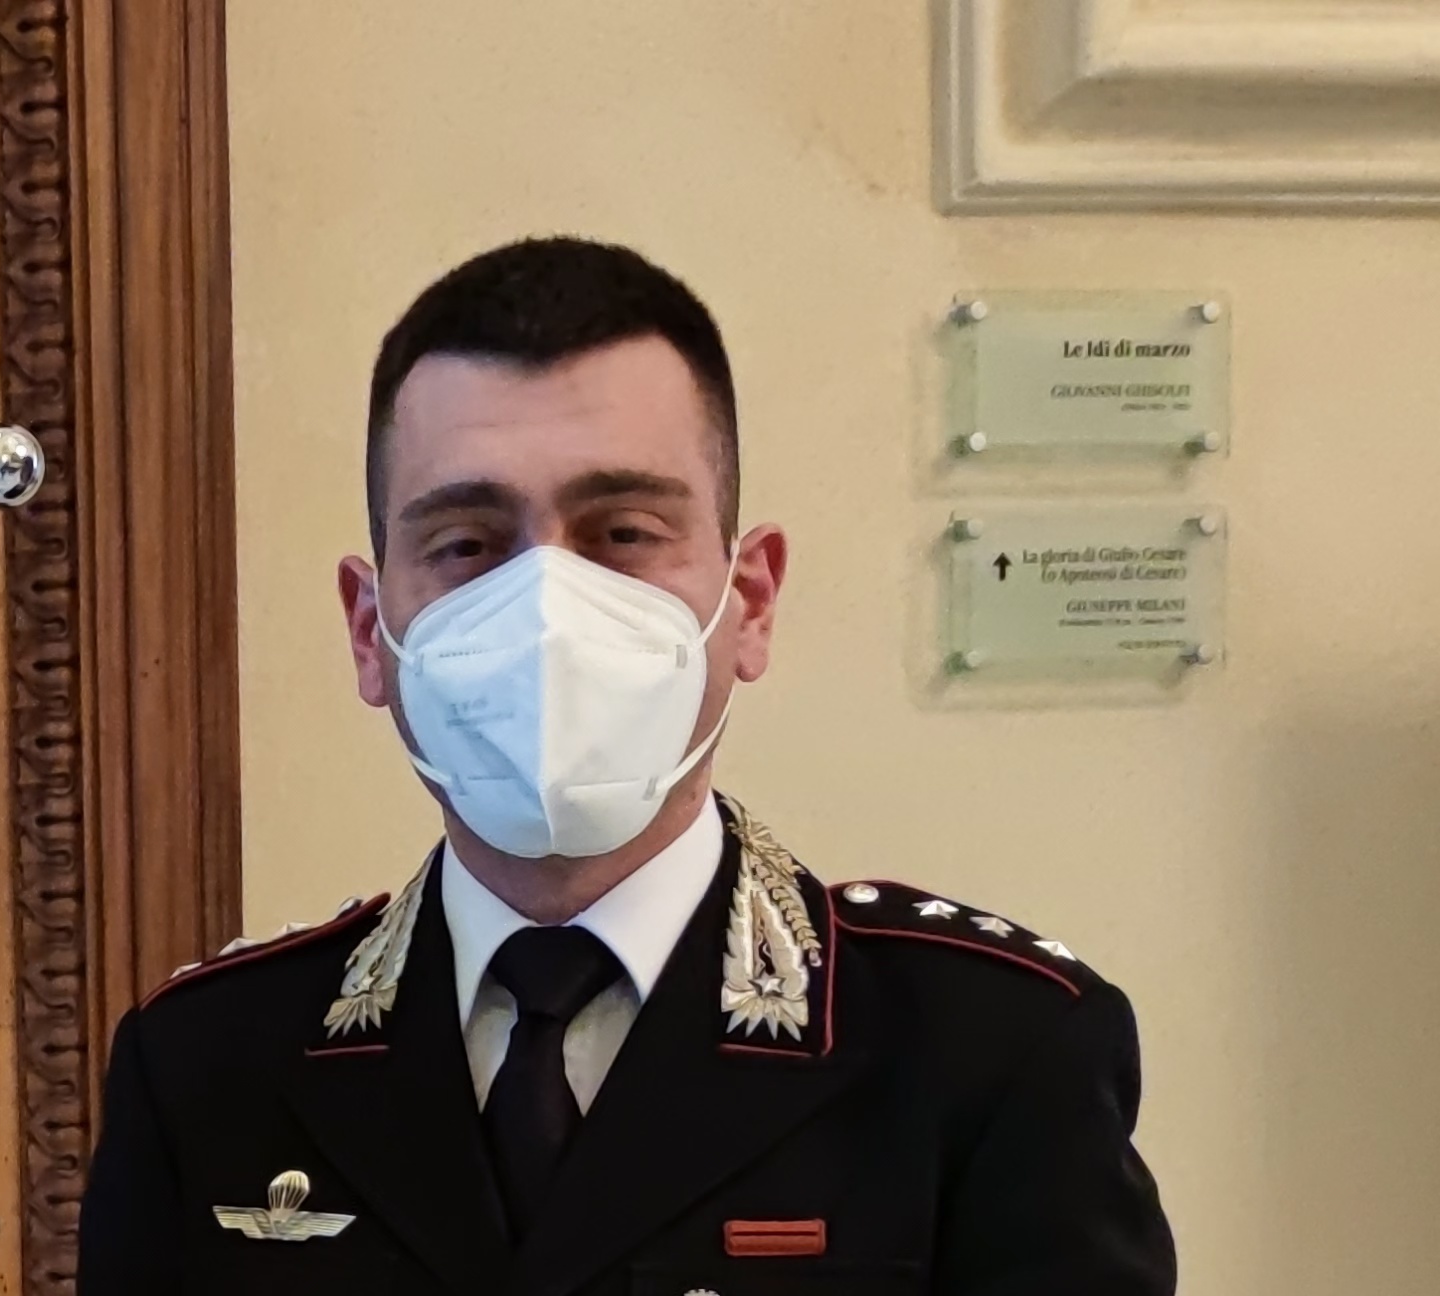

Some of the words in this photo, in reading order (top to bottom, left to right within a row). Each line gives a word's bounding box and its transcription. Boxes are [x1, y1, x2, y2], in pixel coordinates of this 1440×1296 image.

[1063, 339, 1083, 358] Le
[1113, 338, 1132, 358] di
[1135, 343, 1191, 358] marzo
